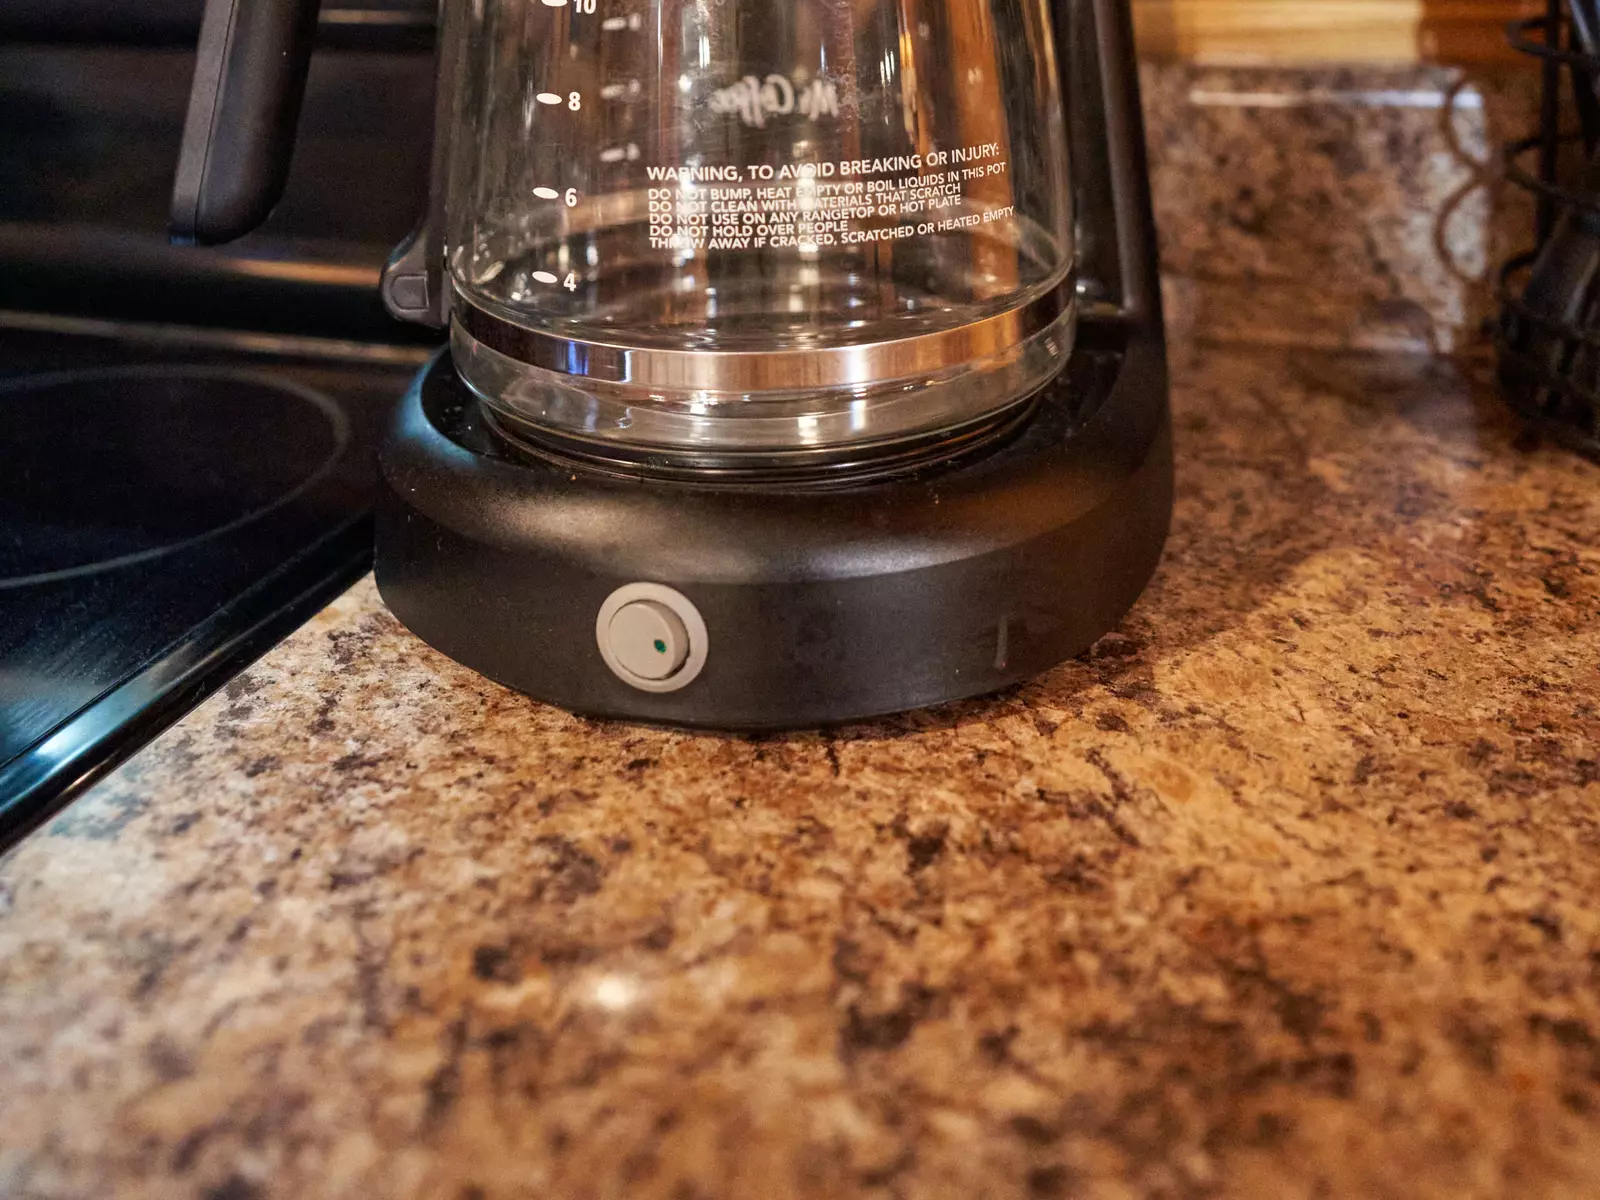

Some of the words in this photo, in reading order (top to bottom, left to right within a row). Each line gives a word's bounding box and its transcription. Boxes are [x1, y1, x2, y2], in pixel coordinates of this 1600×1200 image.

[567, 91, 581, 111] 8
[646, 165, 743, 182] WARNING,
[747, 164, 774, 180] TO
[778, 162, 835, 179] AVOID
[840, 154, 922, 176] BREAKING
[926, 152, 948, 166] OR
[951, 142, 1000, 164] INJURY:
[565, 188, 578, 207] 6
[648, 188, 671, 201] DO
[675, 188, 707, 201] NOT
[711, 188, 753, 201] BUMP,
[756, 187, 793, 200] HEAT
[795, 184, 840, 198] EMPTY
[844, 182, 864, 195] OR
[867, 179, 896, 193] BOIL
[898, 173, 945, 191] LIQUIDS
[947, 171, 960, 183] IN
[962, 166, 985, 181] THIS
[986, 162, 1007, 176] POT
[649, 201, 672, 214] DO
[676, 201, 708, 214] NOT
[711, 200, 758, 213] CLEAN
[761, 199, 798, 212] WITH
[876, 191, 908, 204] THAT
[909, 182, 961, 201] SCRATCH
[649, 213, 673, 226] DO
[676, 213, 709, 226] NOT
[711, 213, 740, 226] USE
[742, 212, 766, 225] ON
[769, 211, 799, 224] ANY
[802, 207, 875, 222] RANGETOP
[878, 204, 897, 217] OR
[900, 199, 926, 214] HOT
[927, 194, 962, 210] PLATE
[649, 225, 673, 237] DO
[676, 225, 709, 237] NOT
[712, 225, 754, 237] HOLD
[756, 223, 795, 236] OVER
[798, 219, 849, 234] PEOPLE
[708, 236, 751, 249] AWAY
[753, 235, 767, 248] IF
[769, 233, 838, 248] CRACKED,
[840, 225, 915, 244] SCRATCHED
[917, 223, 936, 235] OR
[937, 214, 981, 232] HEATED
[982, 205, 1015, 224] EMPTY
[563, 273, 577, 291] 4
